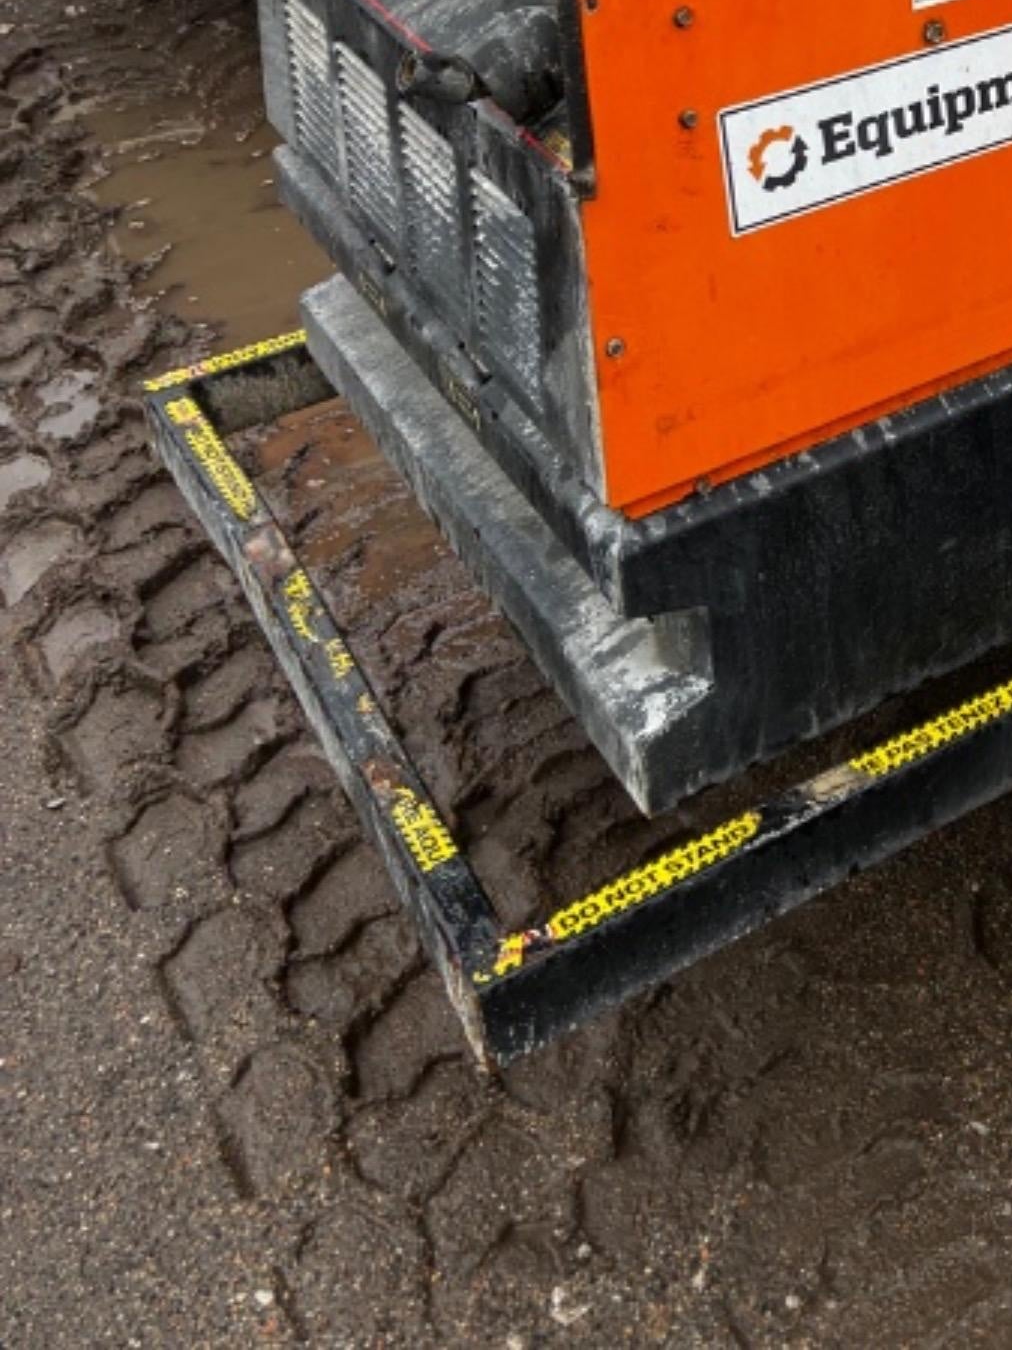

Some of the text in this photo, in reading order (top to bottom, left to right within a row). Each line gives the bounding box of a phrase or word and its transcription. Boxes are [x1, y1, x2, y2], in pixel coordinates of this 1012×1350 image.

[558, 824, 750, 929] DO NOT STAND
